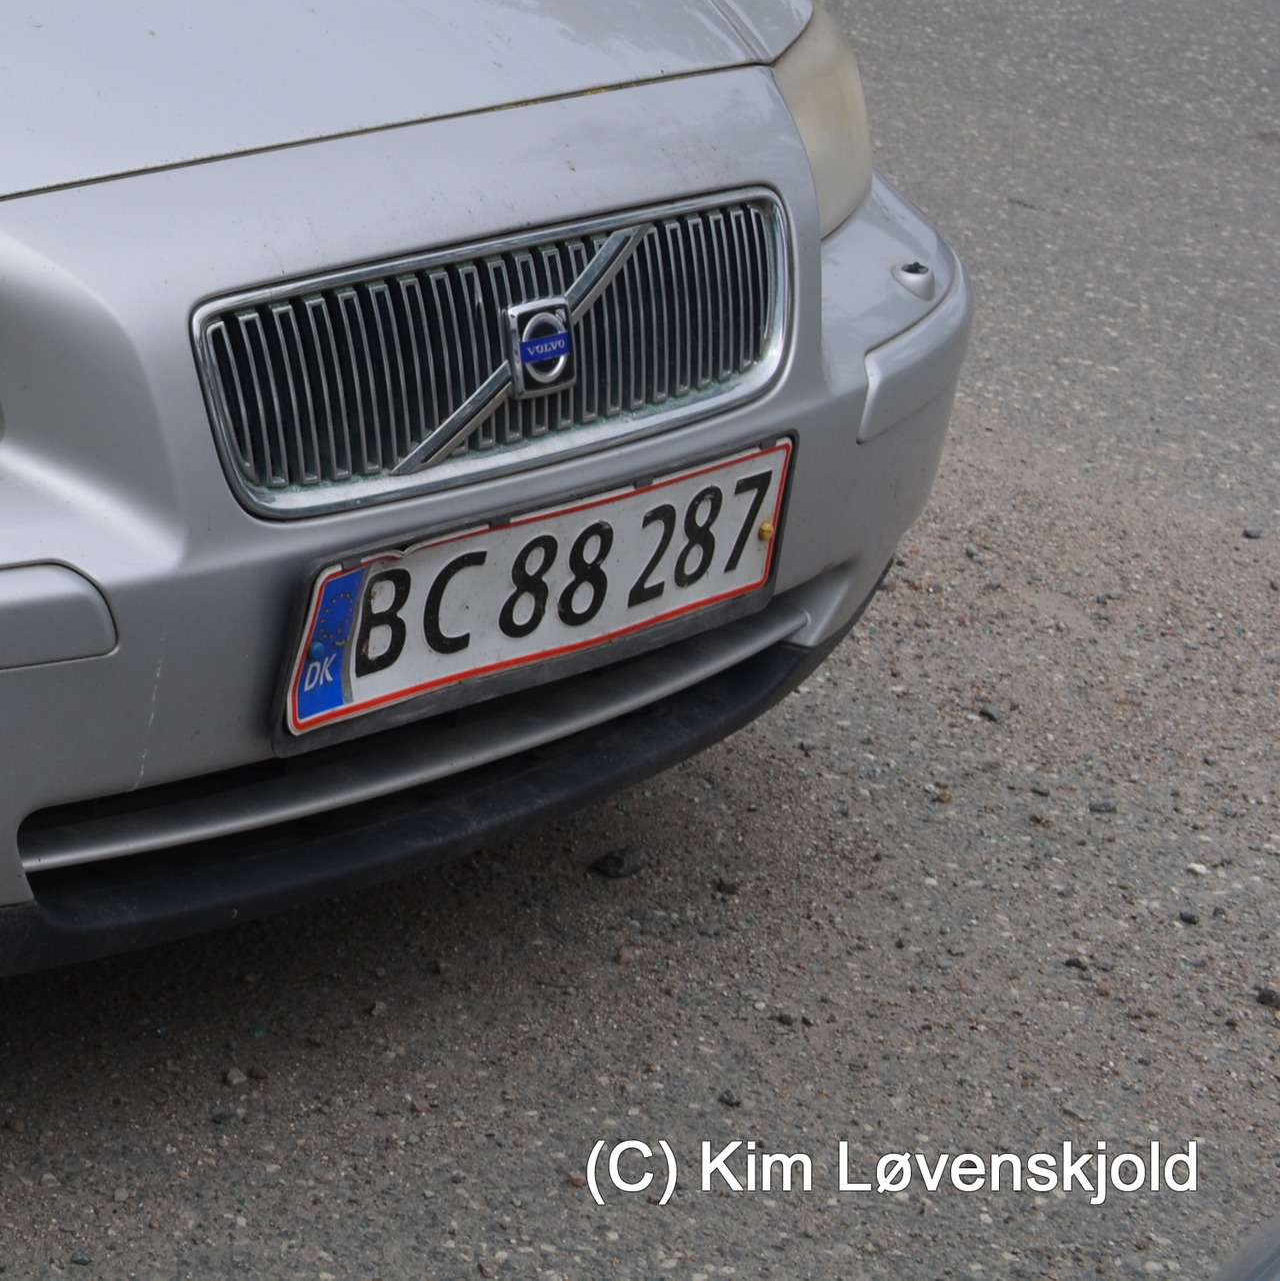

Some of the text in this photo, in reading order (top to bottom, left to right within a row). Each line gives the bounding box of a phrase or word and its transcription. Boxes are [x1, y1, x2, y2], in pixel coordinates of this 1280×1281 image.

[526, 339, 566, 356] VOLVO
[354, 469, 773, 679] BC 88 287
[303, 652, 337, 692] DK
